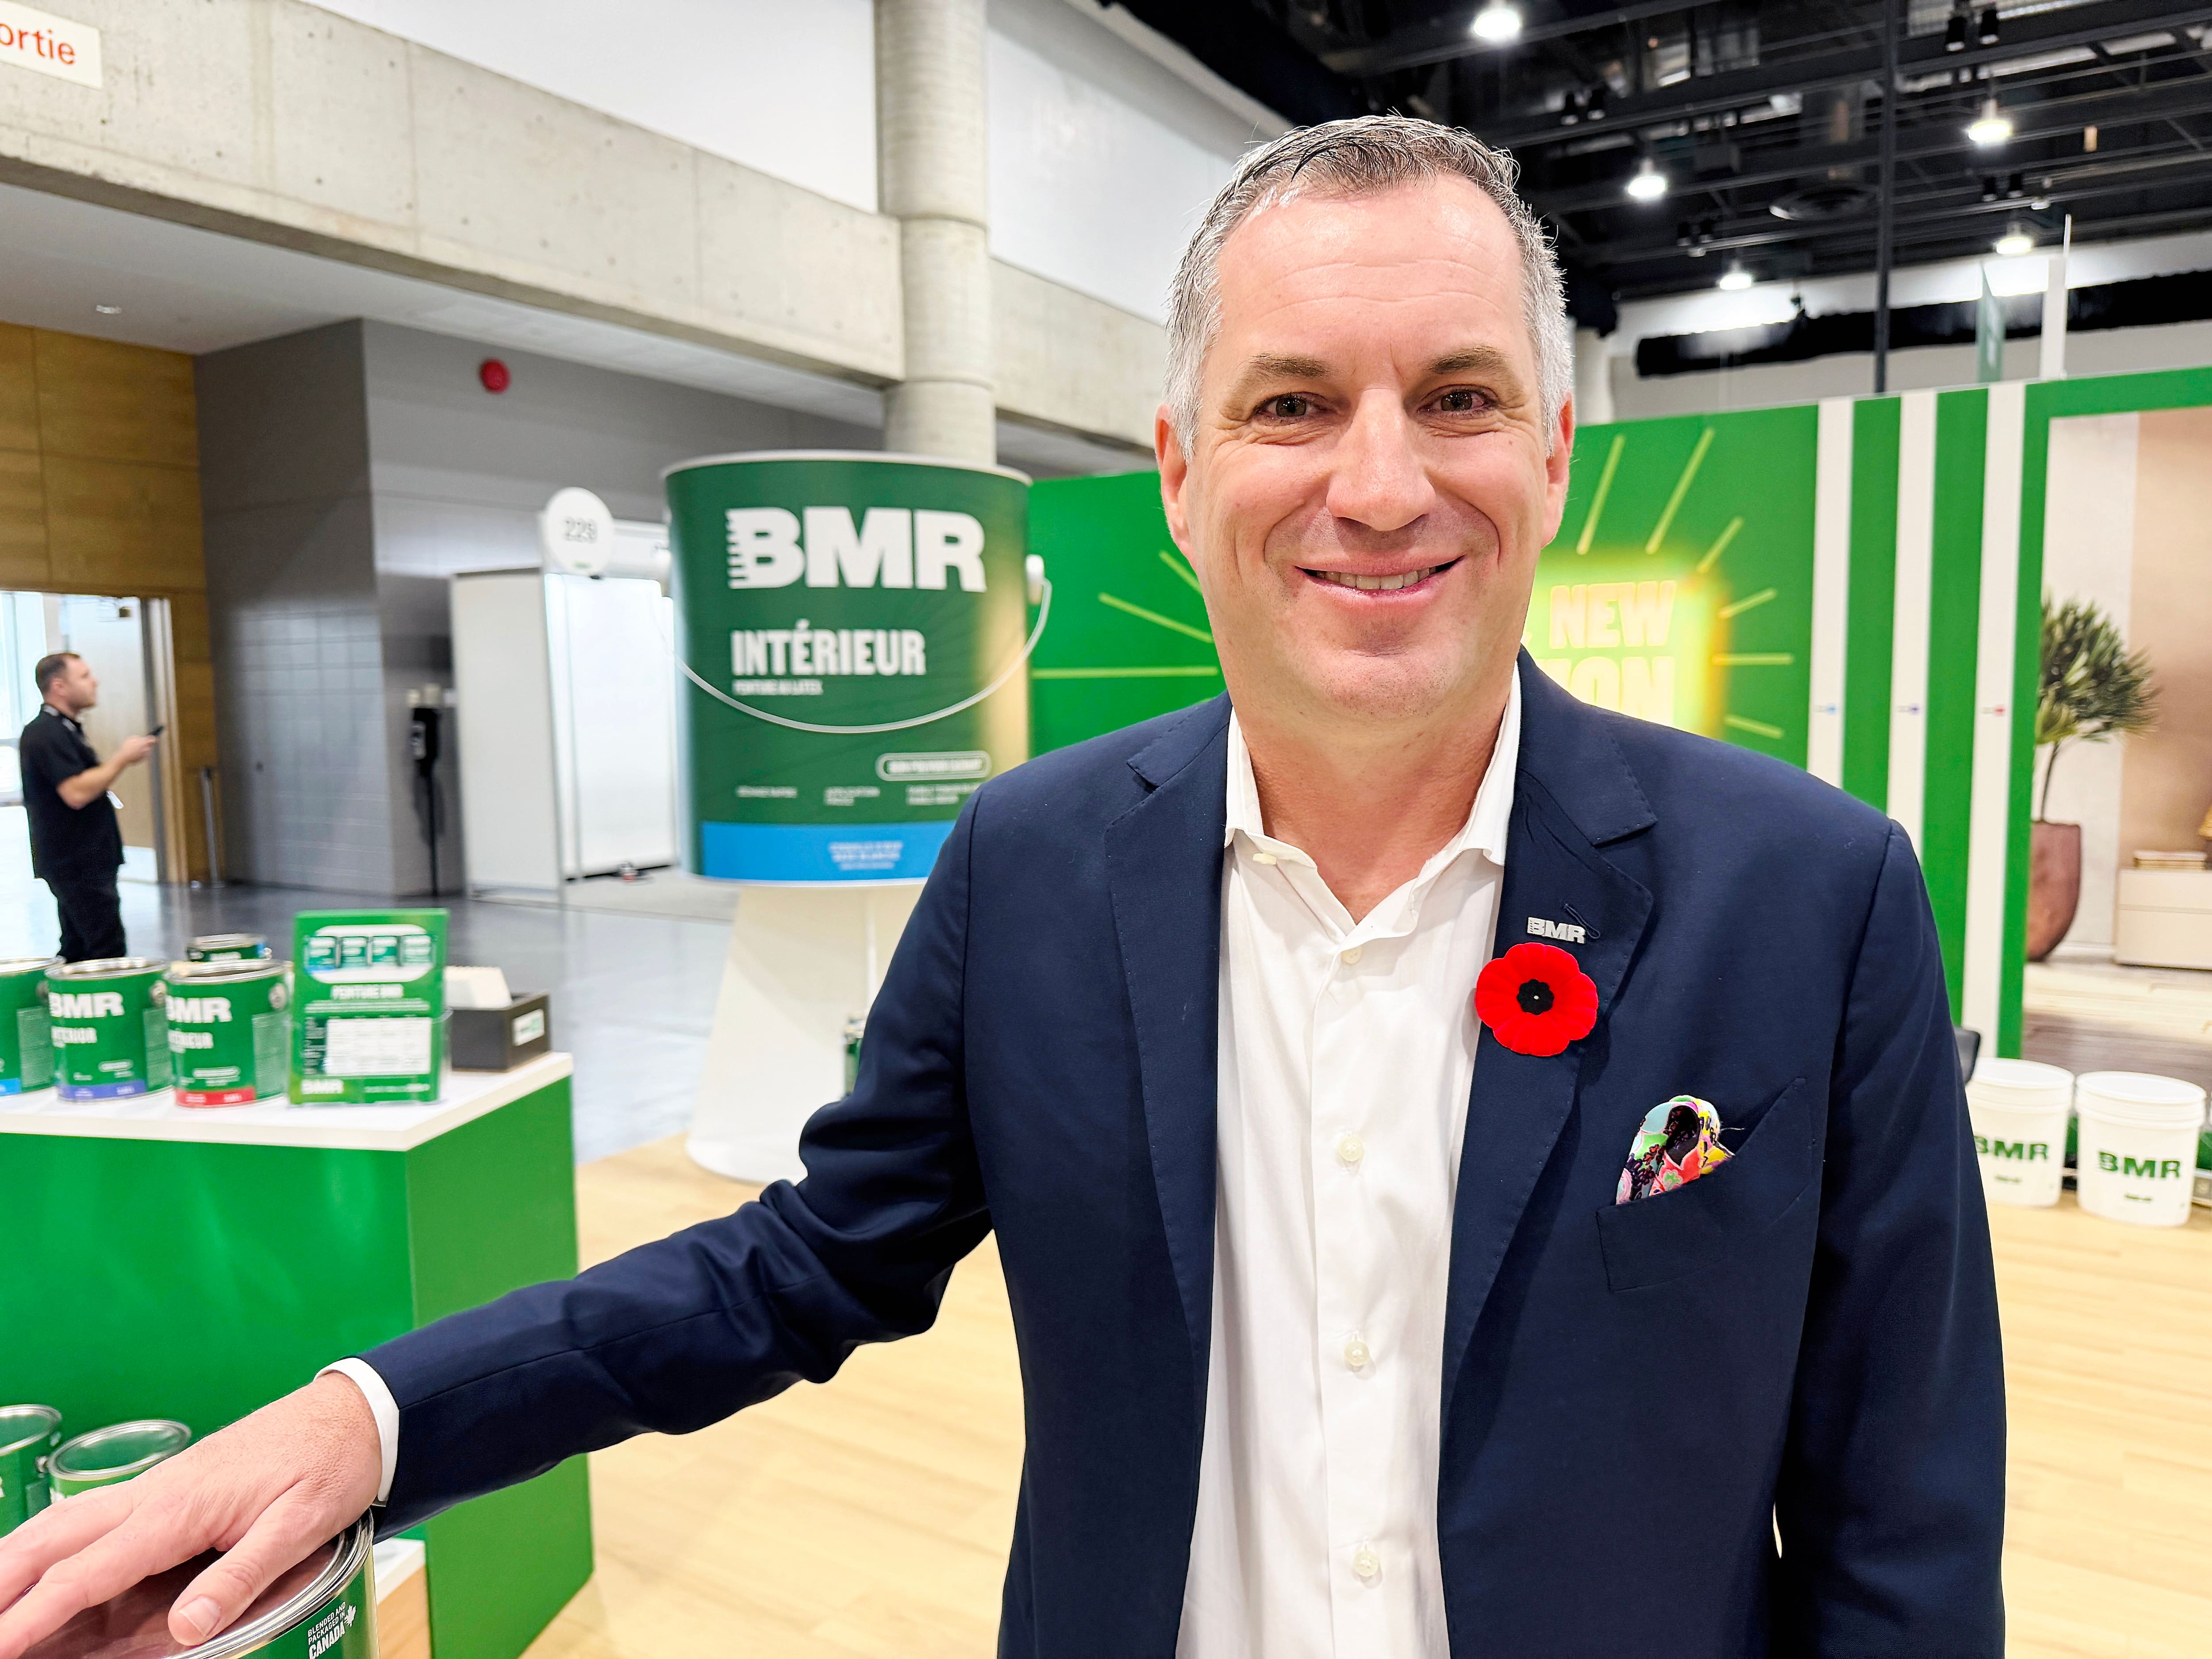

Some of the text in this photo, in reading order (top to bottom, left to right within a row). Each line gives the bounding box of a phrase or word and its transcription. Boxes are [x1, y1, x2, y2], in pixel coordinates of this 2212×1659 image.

[0, 23, 75, 65] ortie
[726, 506, 987, 592] BMR
[1549, 580, 1677, 649] NEW
[730, 619, 927, 676] INTÉRIEUR
[1527, 917, 1586, 944] BMR
[49, 991, 125, 1018] BMR
[1973, 1135, 2047, 1160] BMR
[2098, 1151, 2180, 1178] BMR
[308, 1601, 345, 1637] BLENDED AND
[308, 1609, 345, 1645] PACKAGED IN
[309, 1620, 346, 1659] CANADA
